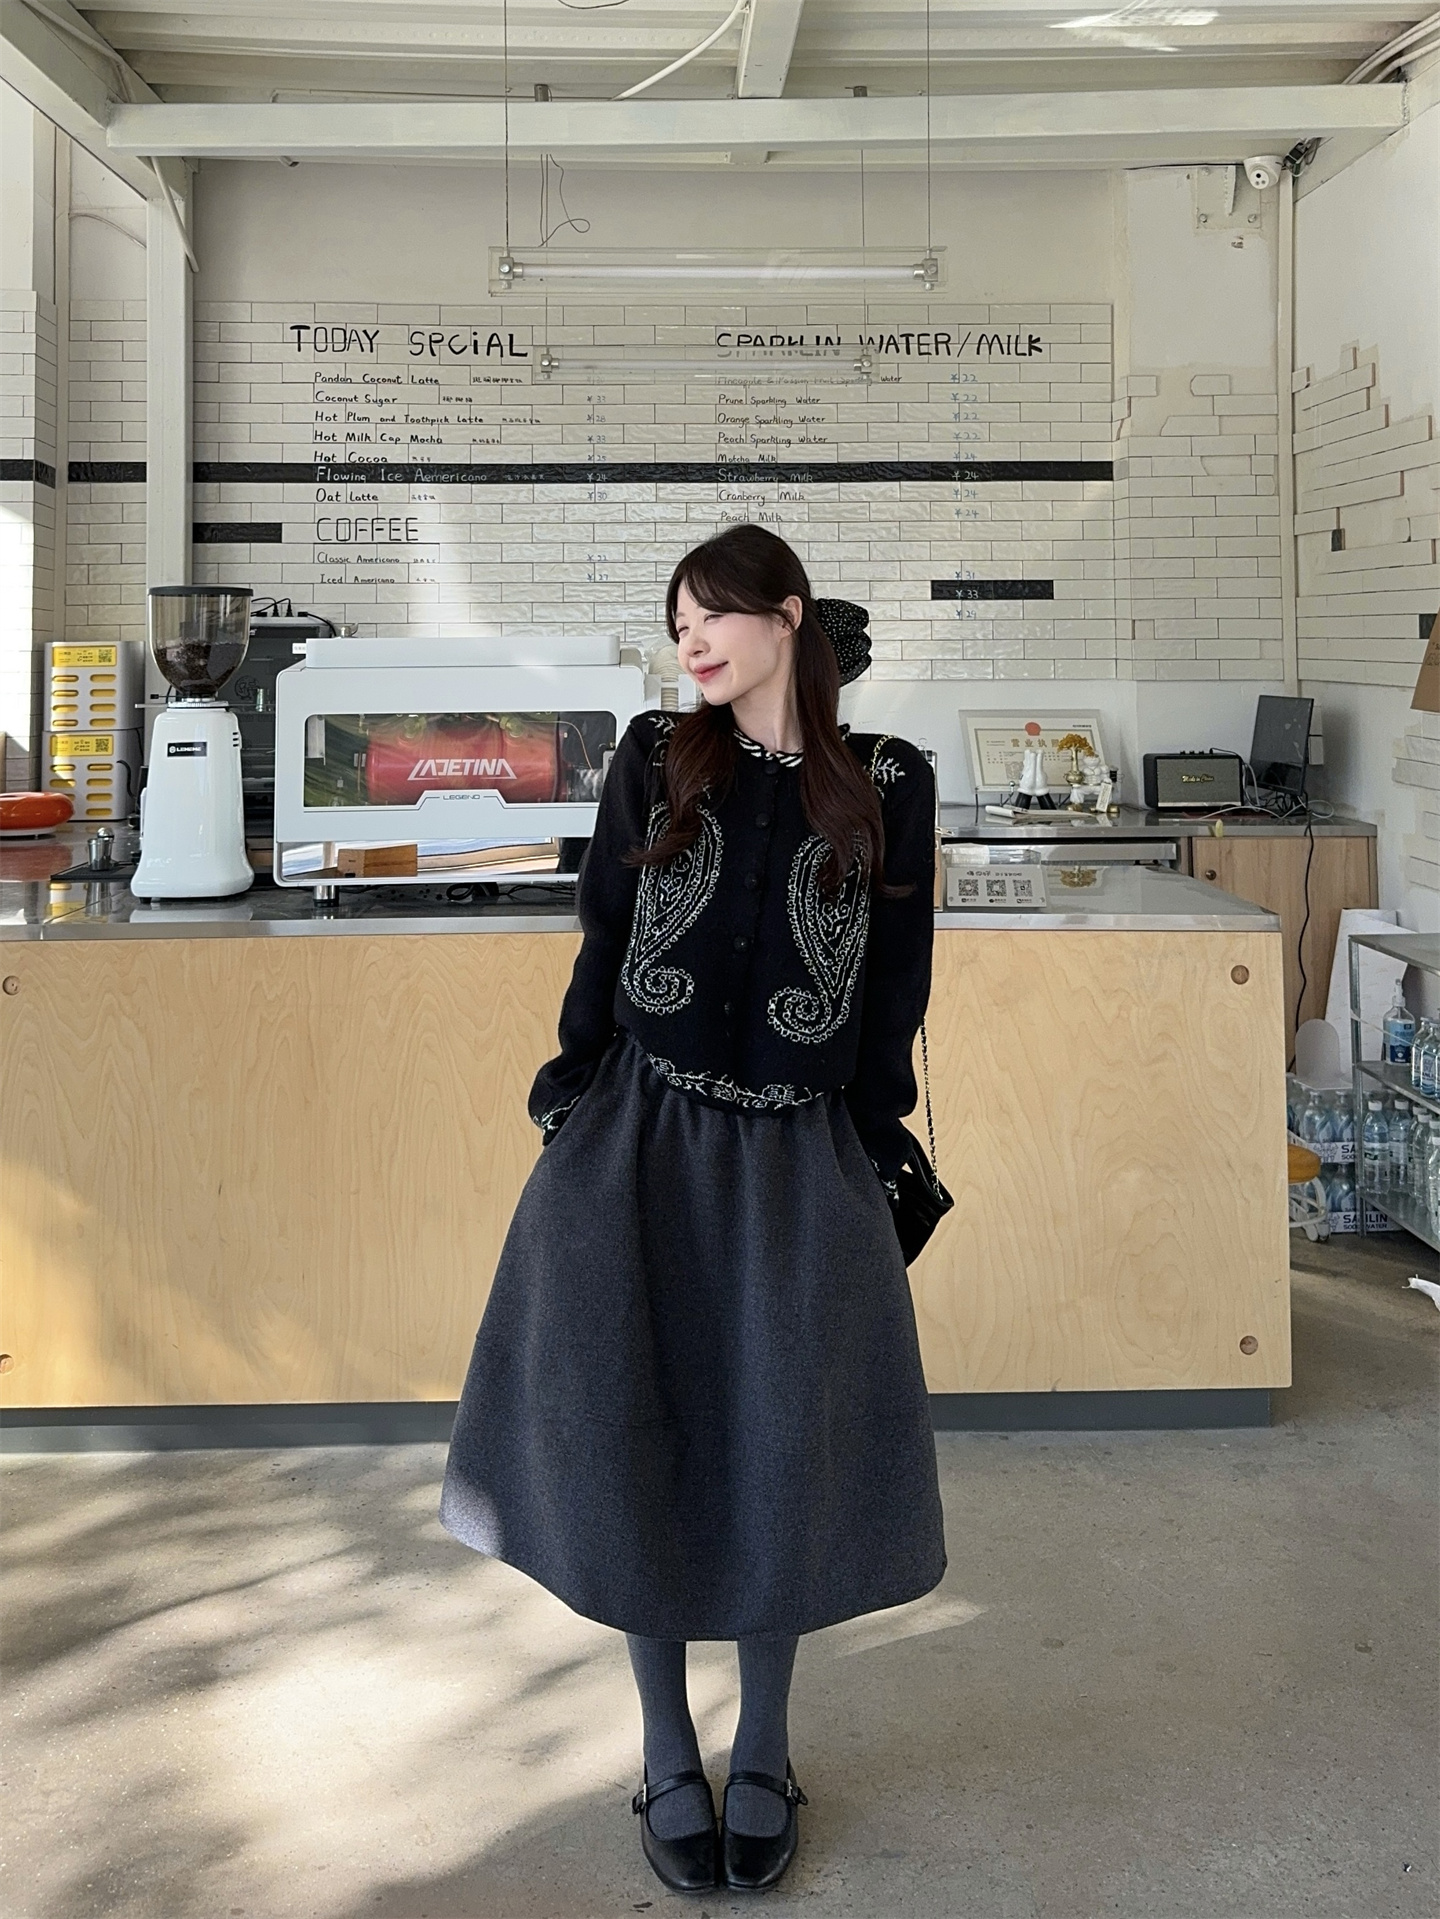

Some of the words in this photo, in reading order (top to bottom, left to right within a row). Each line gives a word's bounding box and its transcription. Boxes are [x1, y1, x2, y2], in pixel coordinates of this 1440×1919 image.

[289, 324, 380, 354] TODAY
[314, 371, 353, 384] Pandan
[362, 373, 403, 385] Coconut
[410, 374, 440, 385] Latte
[314, 389, 359, 403] Coconut
[365, 393, 398, 407] Sugar
[718, 393, 744, 404] Prune
[795, 395, 821, 405] Water
[315, 411, 338, 422] Hot
[346, 411, 371, 422] Plum
[379, 415, 396, 423] and
[404, 414, 450, 426] Toothpick
[717, 412, 750, 428] Orange
[798, 415, 826, 423] Water
[314, 430, 338, 442] Hot
[345, 431, 372, 443] Milk
[380, 432, 401, 445] Cap
[410, 434, 443, 444] Mocha
[718, 432, 745, 444] Peach
[314, 451, 337, 463] Hot
[347, 451, 388, 463] Cocoa
[758, 453, 777, 462] Milk
[316, 465, 366, 482] Flowing
[380, 468, 404, 482] Ice
[717, 468, 779, 483] Strawberry
[789, 473, 813, 483] Milk
[315, 488, 342, 503] Oat
[718, 489, 766, 507] Cranberry
[779, 491, 806, 501] Milk
[720, 511, 750, 522] Peach
[758, 512, 783, 523] Milk
[316, 517, 420, 542] COFFEE
[317, 551, 352, 564] Classic
[356, 554, 400, 564] Americano
[320, 573, 343, 584] Iced
